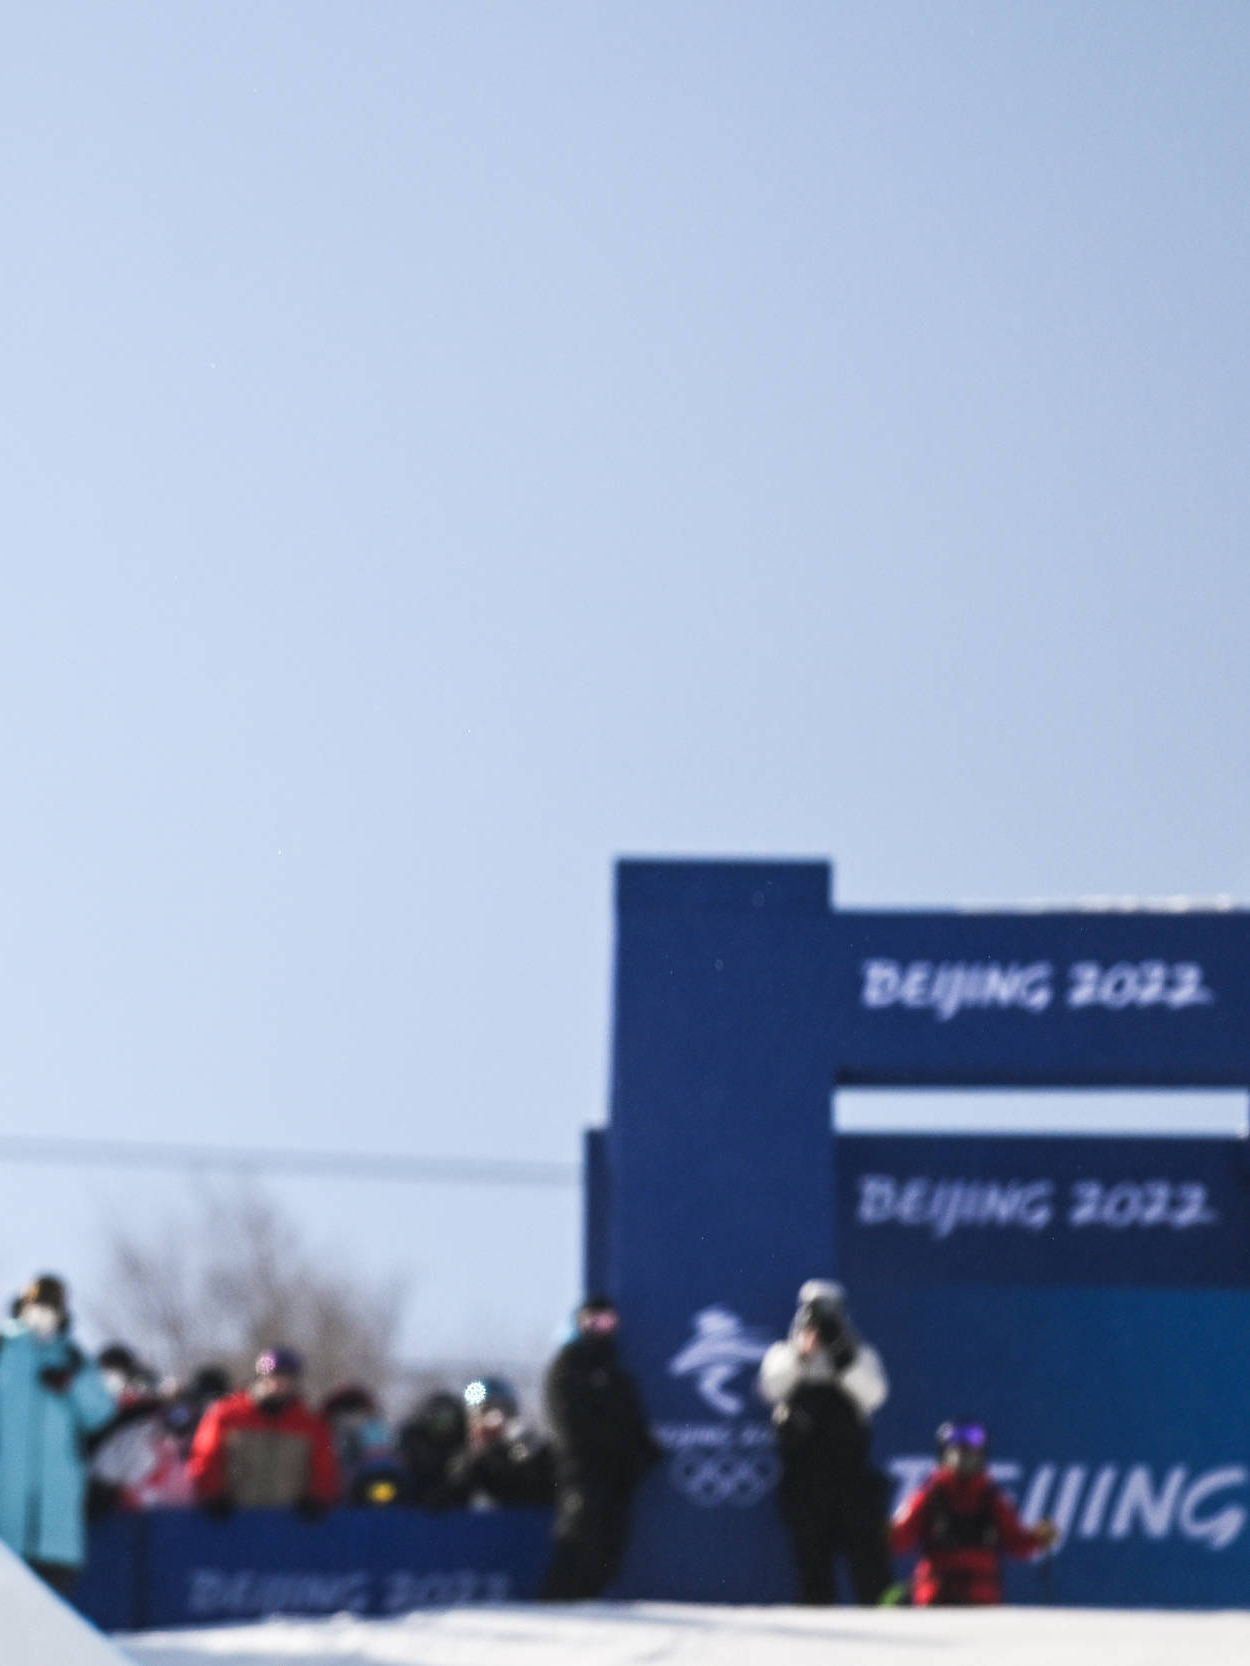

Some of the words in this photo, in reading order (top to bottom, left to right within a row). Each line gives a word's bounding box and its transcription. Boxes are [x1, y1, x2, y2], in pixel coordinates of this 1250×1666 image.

[861, 959, 1051, 1020] BEIJING
[1068, 960, 1212, 1008] 2022
[857, 1174, 1051, 1237] BEIJING
[1069, 1177, 1217, 1228] 2022
